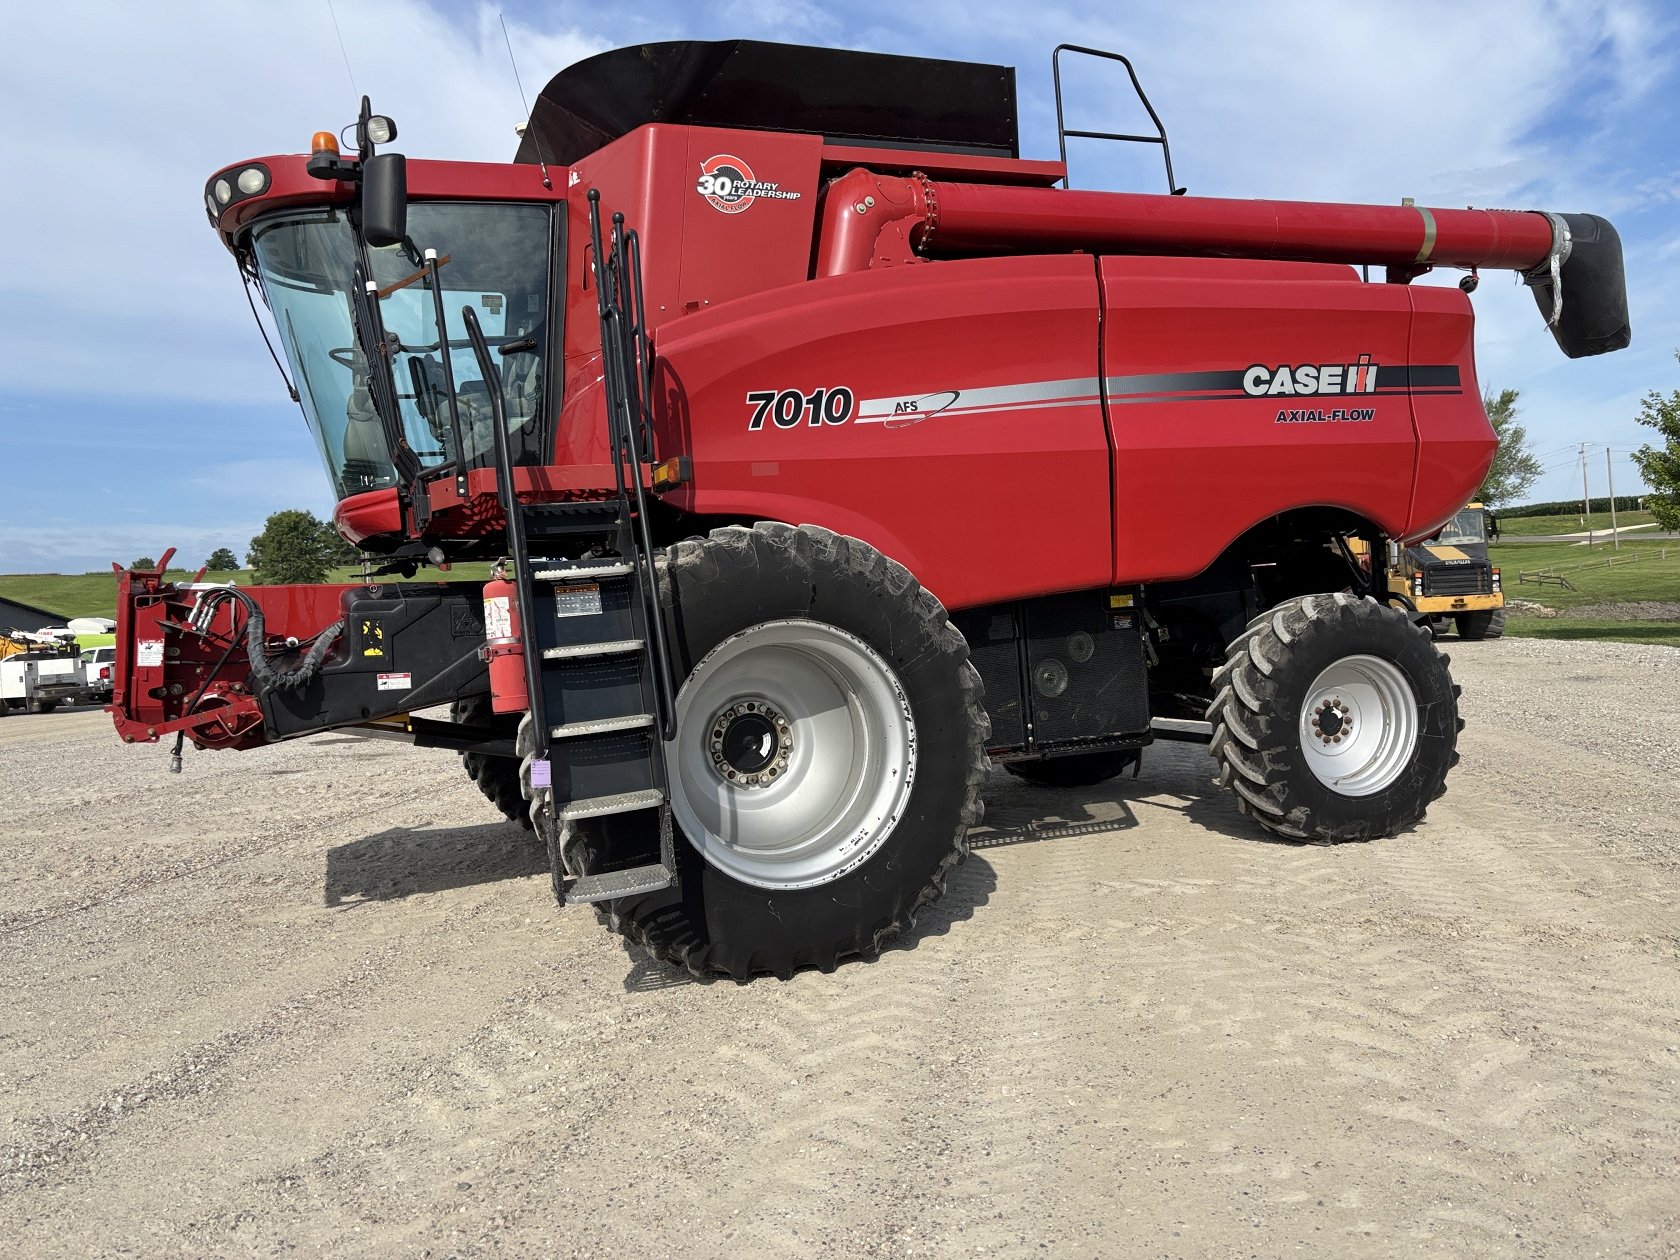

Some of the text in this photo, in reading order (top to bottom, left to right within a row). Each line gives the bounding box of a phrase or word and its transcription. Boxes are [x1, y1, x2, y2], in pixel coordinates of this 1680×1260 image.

[697, 175, 778, 196] 30 ROTARY
[731, 188, 801, 200] LEADERSHIP
[711, 198, 748, 211] AXIAL FLOW
[1243, 365, 1343, 396] CASE
[746, 386, 854, 431] 7010
[894, 400, 918, 413] AFS
[1275, 408, 1376, 423] AXIAL-FLOW
